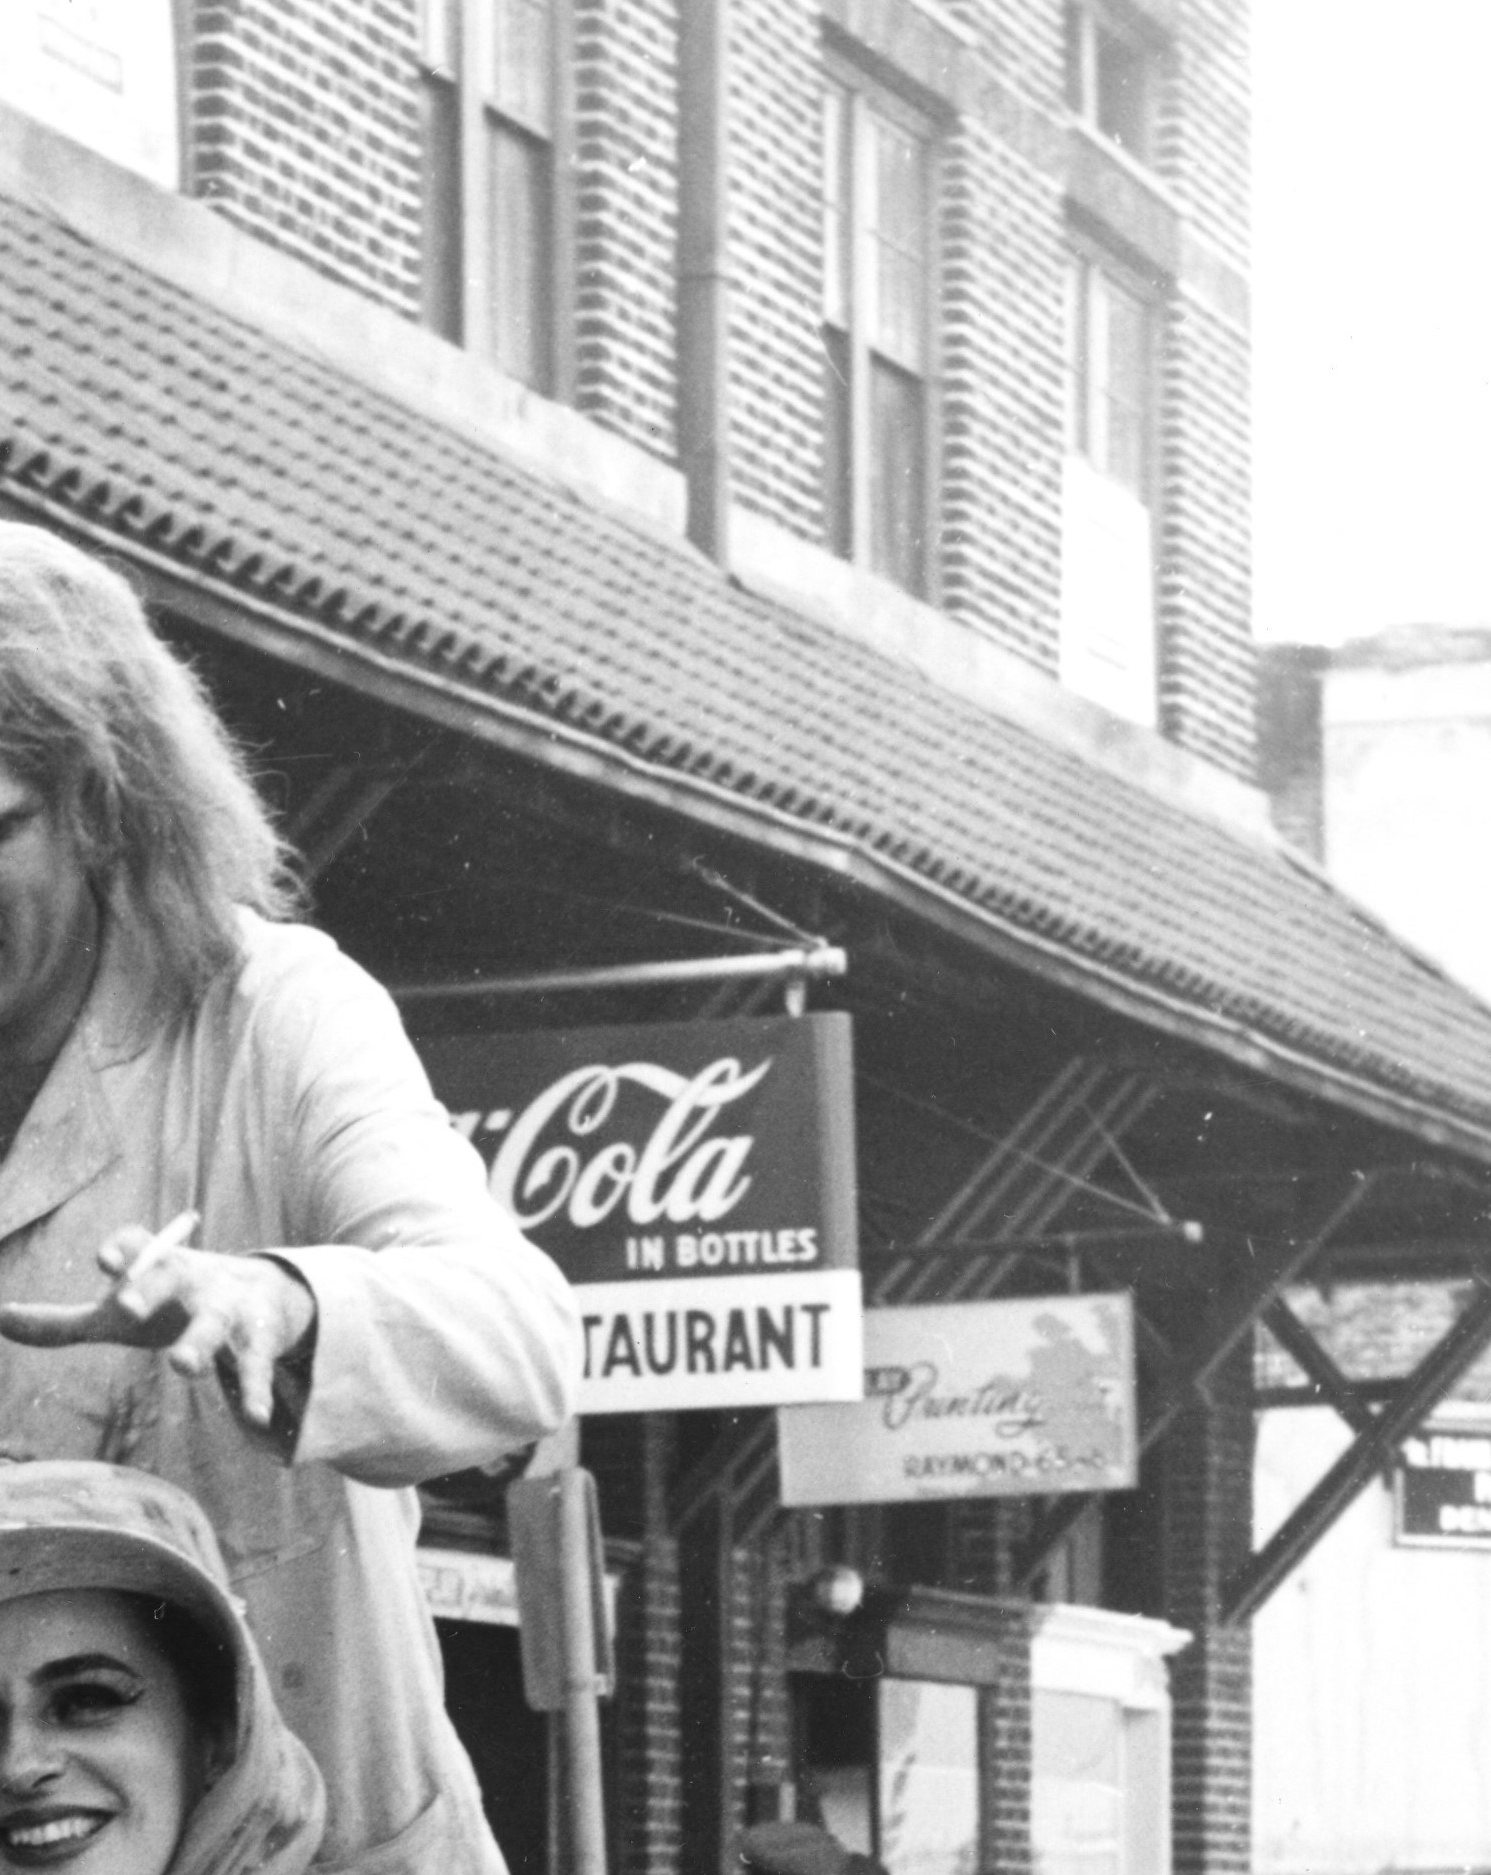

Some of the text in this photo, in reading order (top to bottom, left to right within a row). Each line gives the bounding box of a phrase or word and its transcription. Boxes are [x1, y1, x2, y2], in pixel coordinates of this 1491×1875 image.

[447, 1056, 774, 1229] -Cola
[626, 1227, 818, 1271] IN BOTTLES
[582, 1303, 831, 1380] TAURANT
